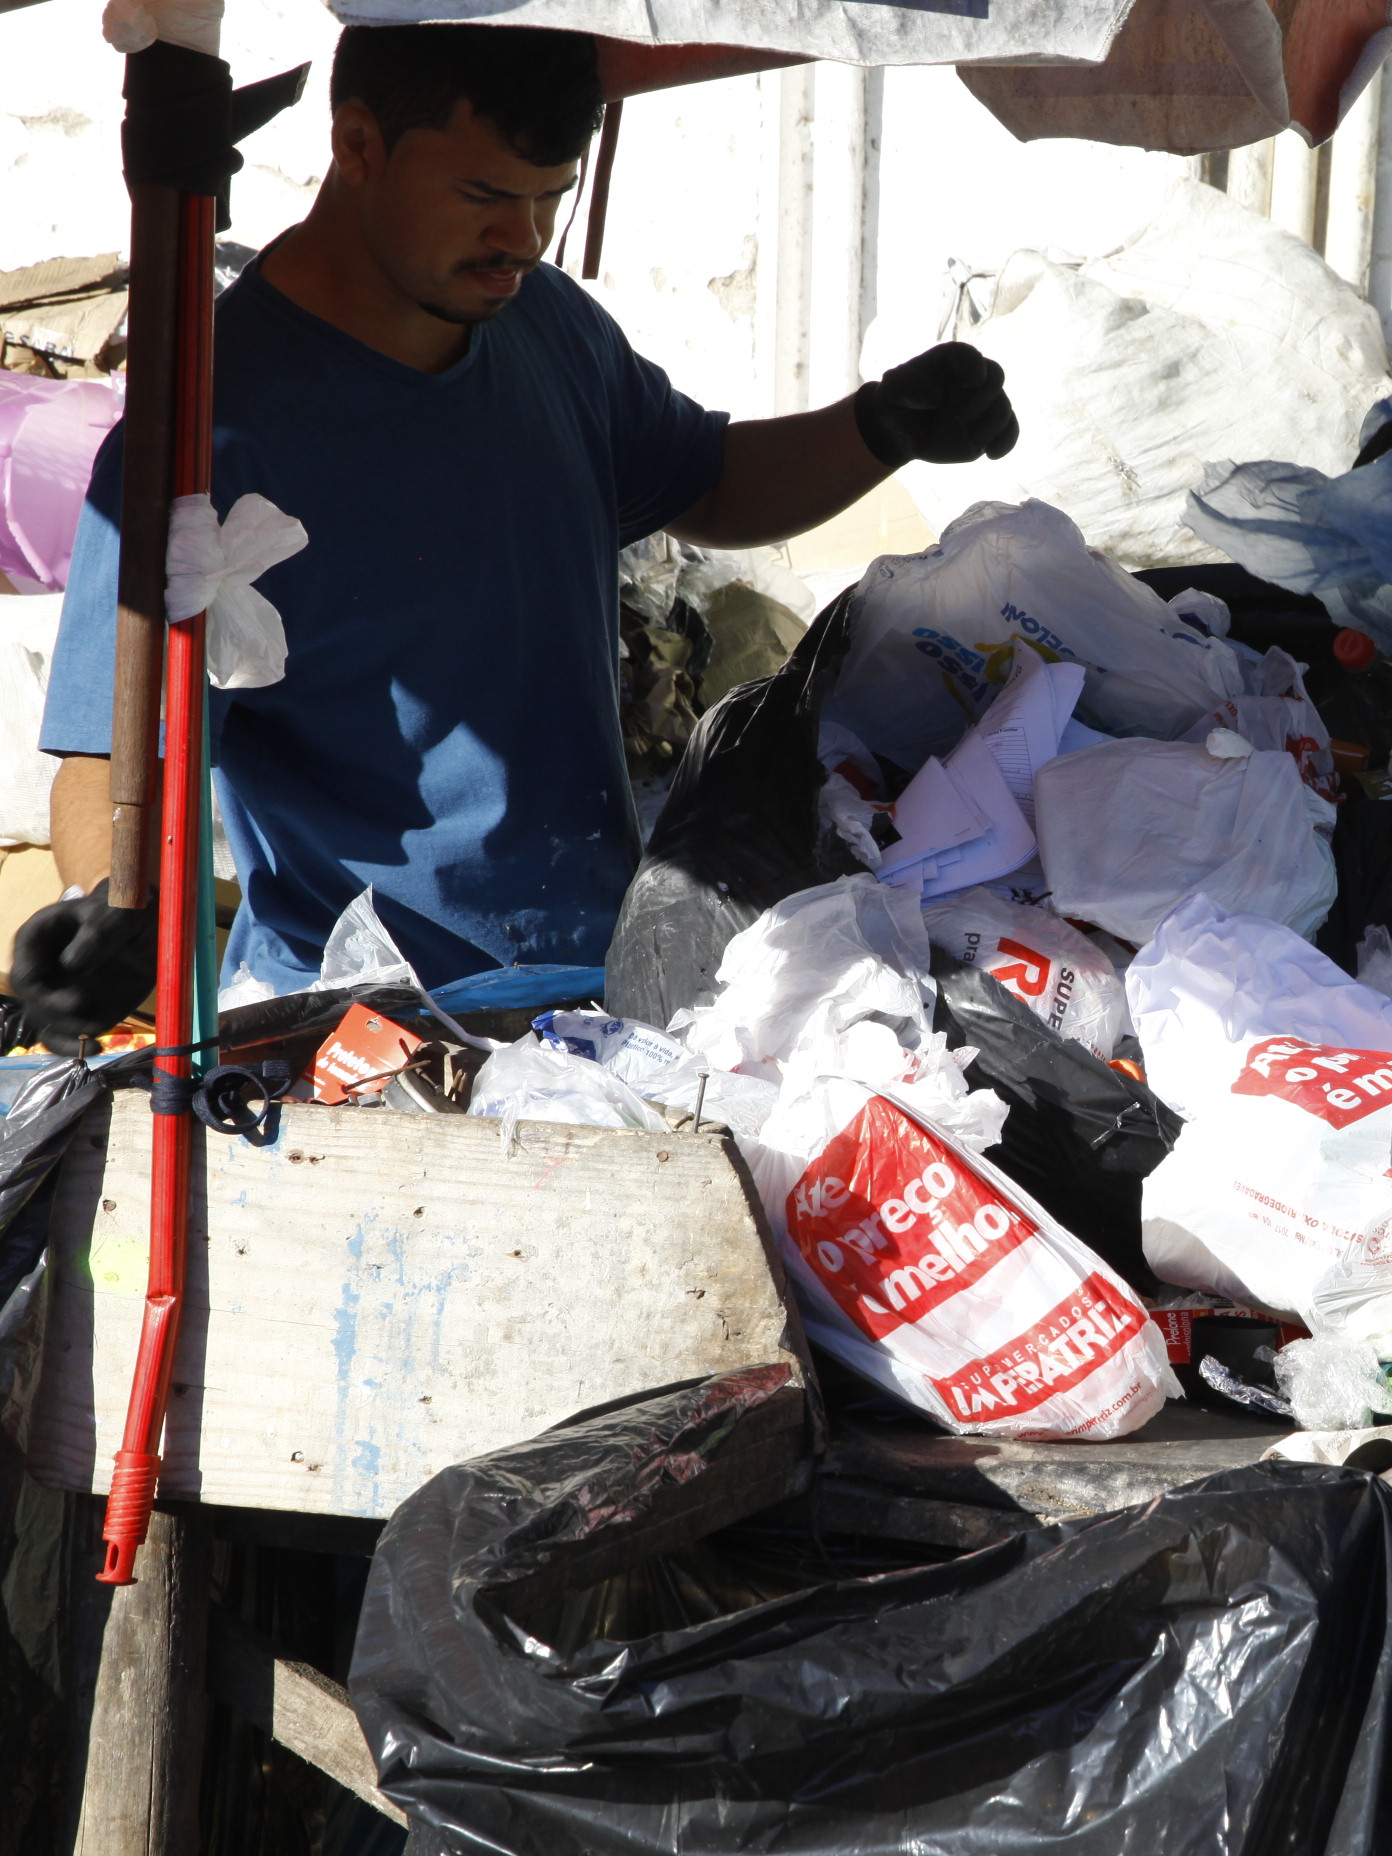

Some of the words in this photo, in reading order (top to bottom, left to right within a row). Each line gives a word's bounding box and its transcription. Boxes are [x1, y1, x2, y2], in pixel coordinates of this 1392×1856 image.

[963, 932, 981, 963] pra
[645, 1050, 664, 1063] 100%
[1285, 1067, 1318, 1083] o
[1321, 1082, 1363, 1110] é
[817, 1241, 845, 1273] o
[836, 1162, 956, 1266] preço
[1163, 1312, 1181, 1346] Prelone
